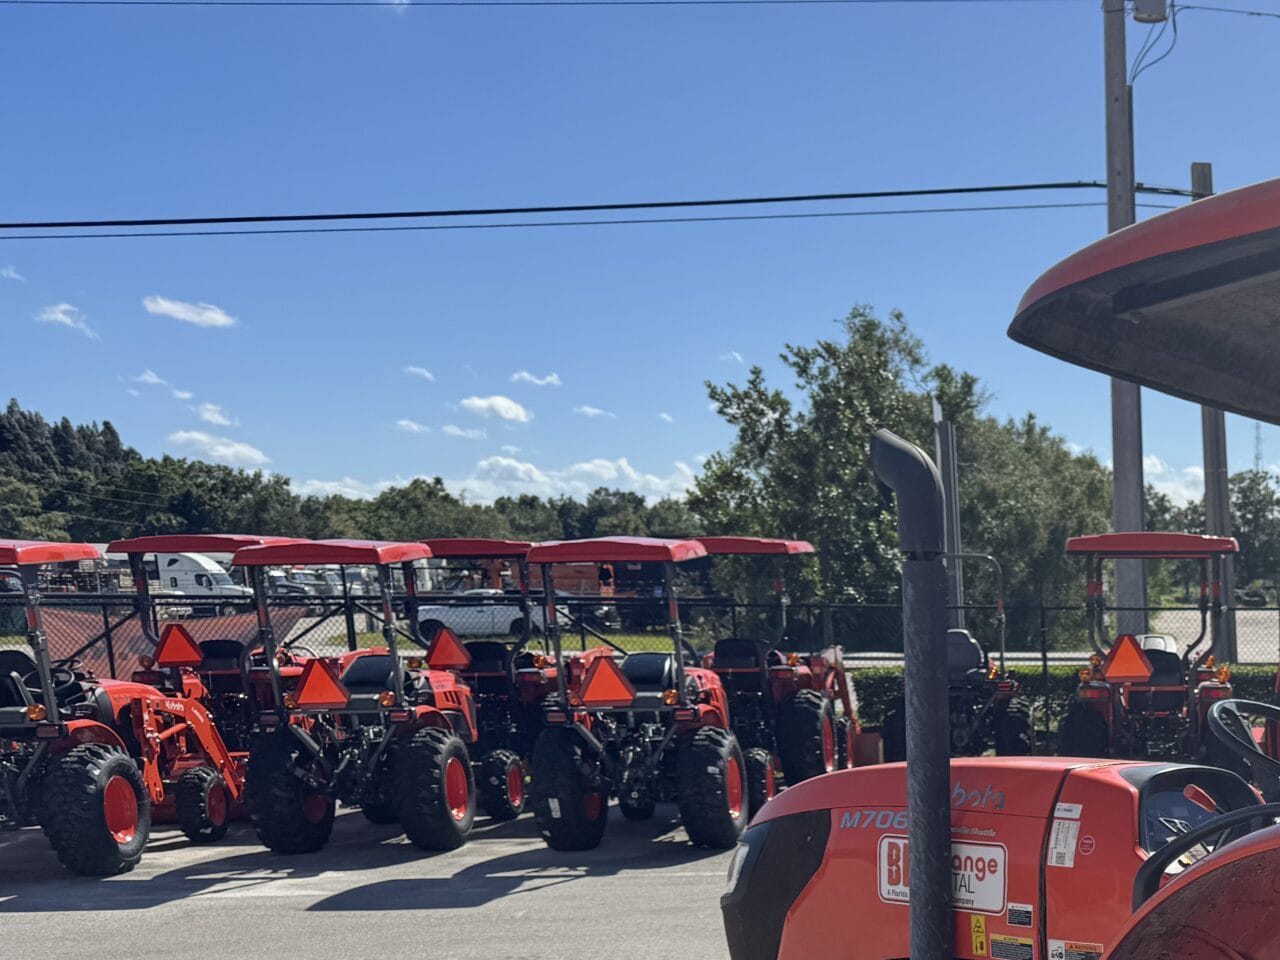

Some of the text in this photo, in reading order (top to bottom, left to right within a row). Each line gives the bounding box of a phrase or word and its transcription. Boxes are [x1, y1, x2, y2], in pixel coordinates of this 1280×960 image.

[951, 782, 1007, 810] bota
[840, 810, 911, 829] M706
[951, 853, 998, 882] ange
[952, 872, 975, 894] TAL
